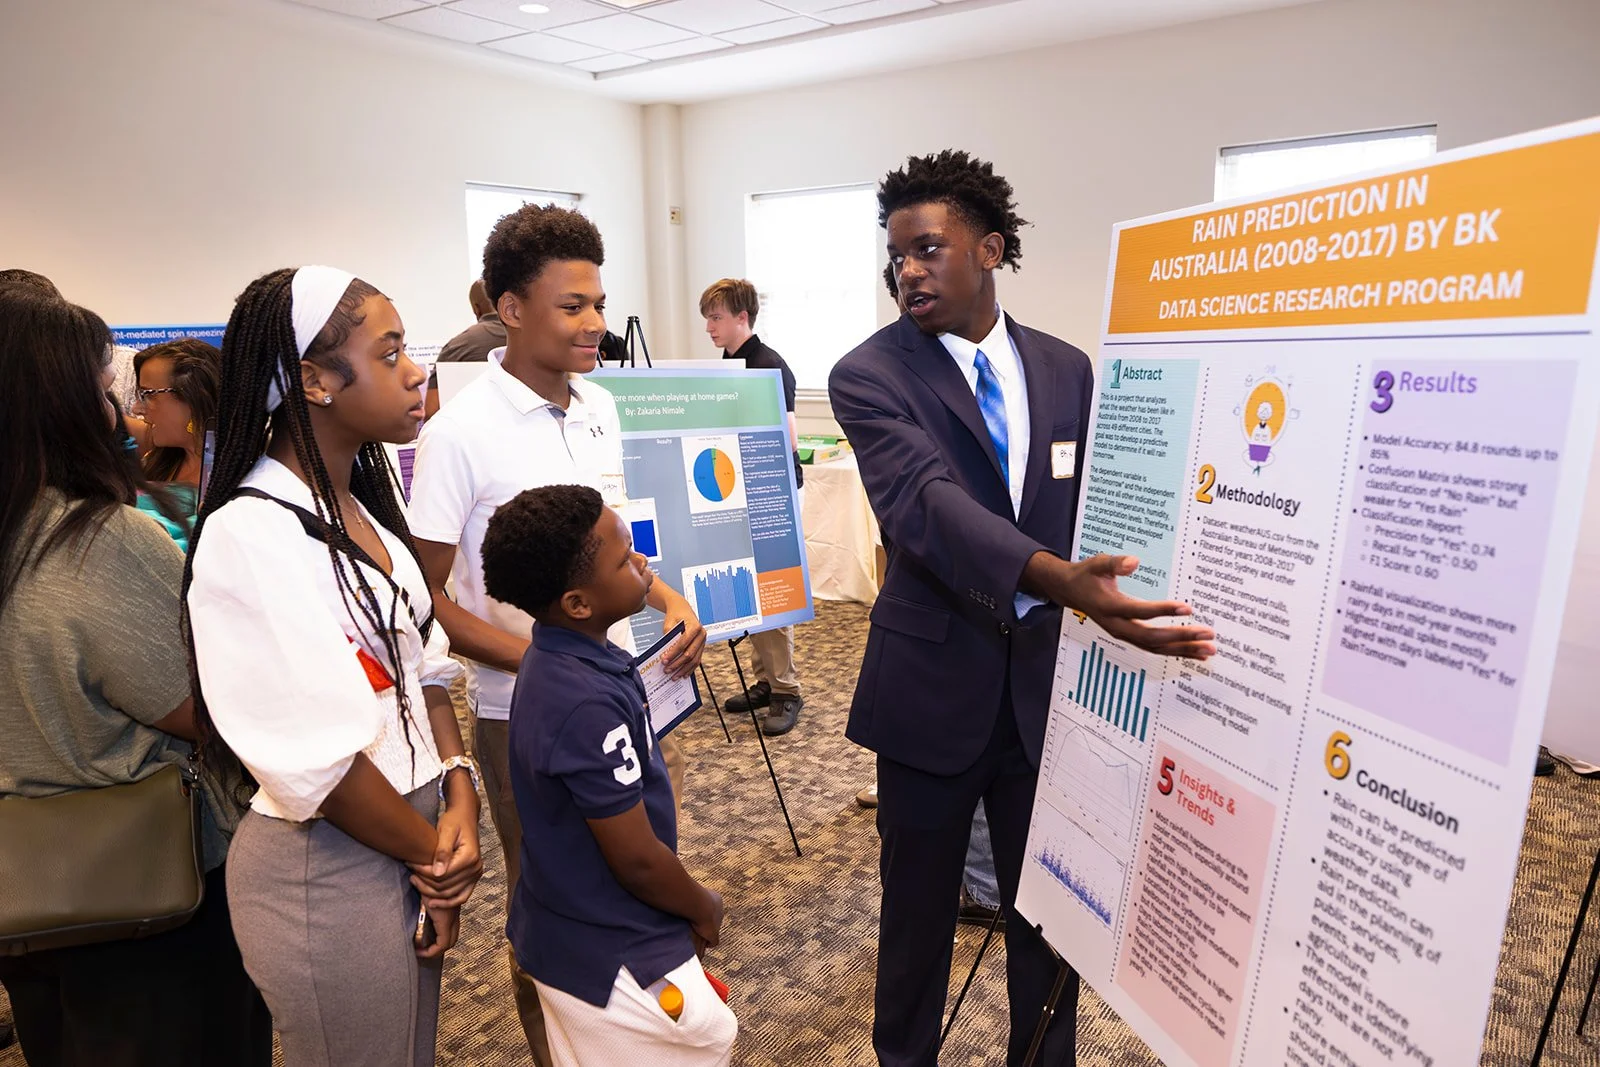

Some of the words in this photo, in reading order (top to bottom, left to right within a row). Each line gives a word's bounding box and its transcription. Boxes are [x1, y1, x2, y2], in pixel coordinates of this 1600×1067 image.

[1192, 209, 1238, 244] RAIN
[1242, 182, 1389, 236] PREDICTION
[1396, 174, 1428, 208] IN
[1149, 245, 1248, 282] AUSTRALIA
[1254, 222, 1397, 272] (2008-2017)
[1405, 216, 1448, 252] BY
[1453, 208, 1502, 246] BK
[1159, 296, 1197, 320] DATA
[1199, 290, 1270, 316] SCIENCE
[1273, 277, 1381, 314] RESEARCH
[1386, 270, 1524, 306] PROGRAM
[168, 330, 184, 339] spin
[1110, 358, 1122, 389] 1
[1122, 366, 1163, 380] Abstract
[1370, 370, 1395, 413] 3
[1399, 371, 1478, 394] Results
[625, 407, 636, 417] By:
[637, 407, 660, 415] Zakaria
[662, 406, 685, 415] Nimale
[647, 393, 665, 401] when
[666, 392, 689, 402] playing
[697, 392, 715, 400] home
[717, 392, 738, 402] games?
[1370, 448, 1389, 459] 85%
[1373, 434, 1401, 445] Model
[1481, 445, 1521, 457] rounds
[1525, 449, 1541, 460] up
[1544, 449, 1558, 460] to
[1195, 464, 1216, 504] 2
[1216, 484, 1300, 517] Methodology
[1363, 495, 1395, 506] weaker
[1397, 497, 1411, 509] for
[1365, 478, 1427, 495] classification
[1429, 487, 1441, 497] of
[1497, 496, 1517, 508] but
[1368, 463, 1415, 478] Confusion
[1418, 469, 1449, 482] Matrix
[1452, 474, 1485, 487] shows
[1489, 480, 1526, 496] strong
[1361, 507, 1423, 526] Classification
[1374, 524, 1418, 541] Precision
[1420, 533, 1435, 545] for
[1286, 534, 1304, 545] from
[1306, 539, 1319, 549] the
[1369, 554, 1380, 566] F1
[1372, 539, 1400, 554] Recall
[1402, 545, 1416, 557] for
[1347, 596, 1369, 611] rainy
[1371, 602, 1392, 616] days
[1395, 609, 1404, 618] in
[1454, 626, 1496, 645] months
[1350, 580, 1383, 597] Rainfall
[1385, 592, 1446, 613] visualization
[1449, 608, 1482, 624] shows
[1485, 617, 1516, 633] more
[1342, 624, 1375, 641] aligned
[1377, 636, 1396, 647] with
[1398, 642, 1422, 657] days
[1424, 649, 1463, 670] labeled
[1498, 671, 1515, 685] for
[1345, 609, 1379, 627] Highest
[1380, 621, 1414, 638] rainfall
[1416, 632, 1447, 648] spikes
[1450, 642, 1488, 662] mostly
[601, 722, 642, 786] 3
[1157, 756, 1176, 796] 5
[1179, 768, 1224, 807] Insights
[1226, 798, 1236, 816] &
[1324, 730, 1352, 780] 6
[1356, 770, 1459, 834] Conclusion
[1176, 789, 1215, 826] Trends
[1330, 812, 1353, 830] with
[1355, 826, 1362, 836] a
[1365, 828, 1385, 846] fair
[1387, 843, 1430, 873] degree
[1433, 868, 1448, 882] of
[1333, 792, 1356, 813] Rain
[1359, 808, 1380, 825] can
[1382, 818, 1398, 835] be
[1400, 830, 1465, 870] predicted
[1324, 846, 1368, 877] weather
[1326, 829, 1377, 866] accuracy
[1379, 859, 1412, 887] using
[1317, 880, 1334, 897] aid
[1335, 891, 1346, 904] in
[1349, 898, 1367, 918] the
[1369, 913, 1423, 957] planning
[1426, 949, 1441, 963] of
[1320, 860, 1344, 883] Rain
[1345, 878, 1406, 922] prediction
[1409, 918, 1433, 938] can
[1313, 896, 1347, 925] public
[1350, 920, 1400, 962] services,
[1352, 942, 1375, 963] and
[1302, 964, 1349, 1005] effective
[1351, 1001, 1363, 1016] at
[1306, 945, 1324, 967] The
[1326, 963, 1361, 995] model
[1363, 990, 1373, 1004] is
[1376, 999, 1408, 1028] more
[1292, 1011, 1327, 1048] Future
[1298, 981, 1323, 1006] days
[1326, 1000, 1348, 1024] that
[1350, 1021, 1369, 1040] are
[1372, 1037, 1393, 1058] not
[1289, 1030, 1325, 1067] should
